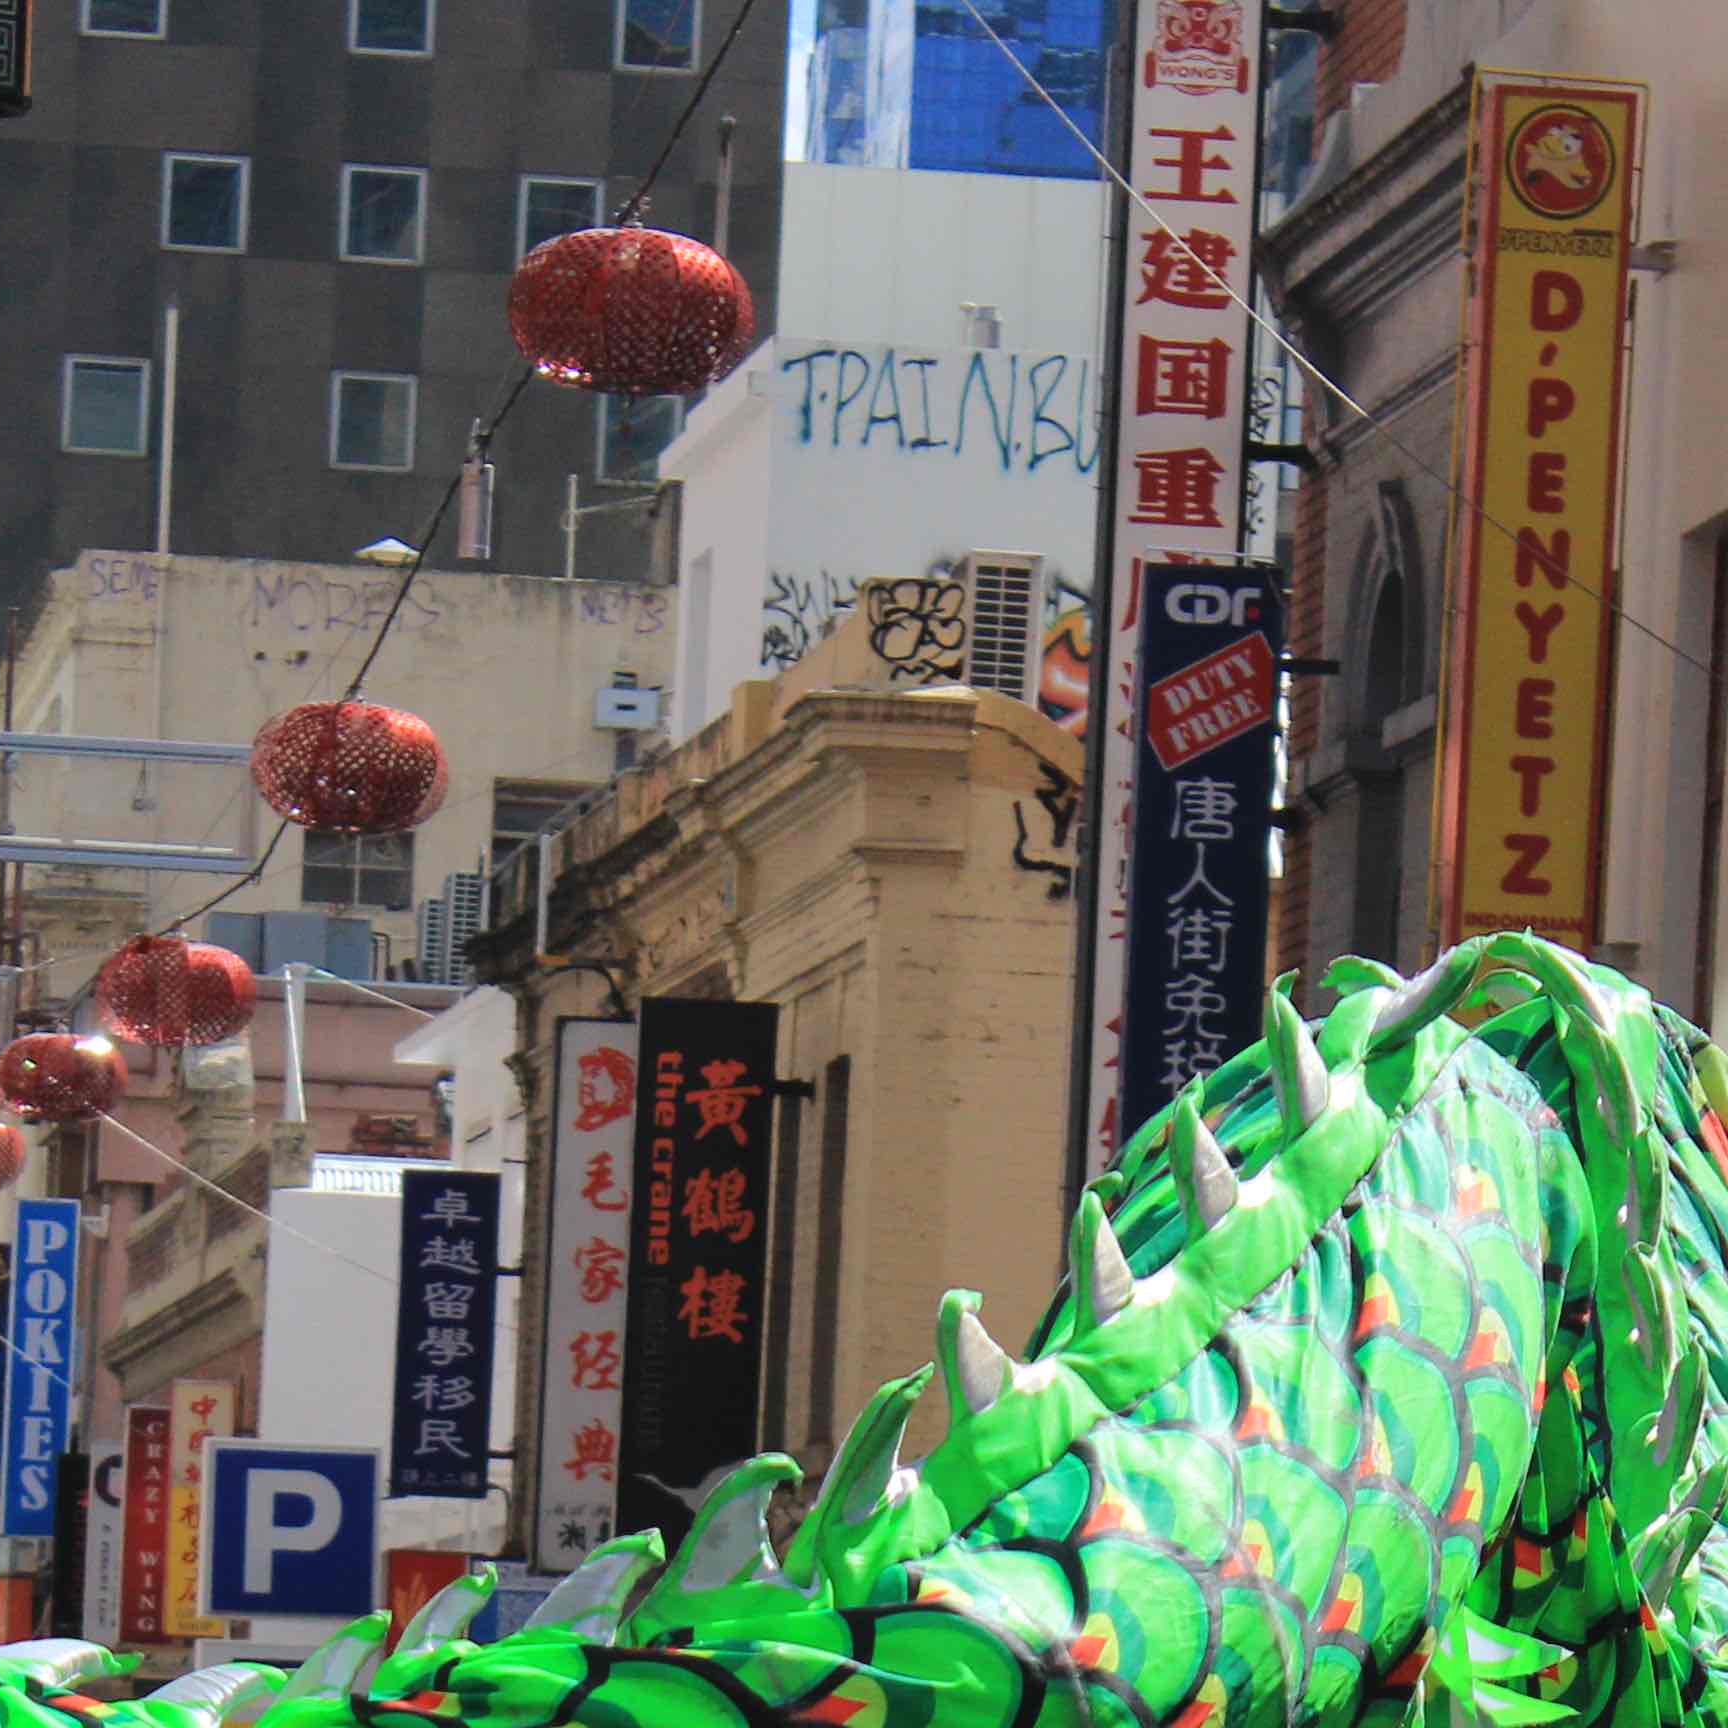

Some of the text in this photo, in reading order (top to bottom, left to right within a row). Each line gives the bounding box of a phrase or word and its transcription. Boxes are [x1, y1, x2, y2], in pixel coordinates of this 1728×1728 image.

[1159, 64, 1236, 81] WONG'S
[1501, 270, 1584, 896] D'PENYETZ
[1162, 649, 1256, 716] DUTY
[1166, 688, 1262, 753] FREE
[654, 1050, 686, 1127] the
[648, 1136, 675, 1266] crane
[20, 1219, 70, 1511] POKIES
[411, 1188, 484, 1458] 卓越留學移民
[136, 1422, 166, 1632] CRAZY WING
[242, 1467, 346, 1596] P
